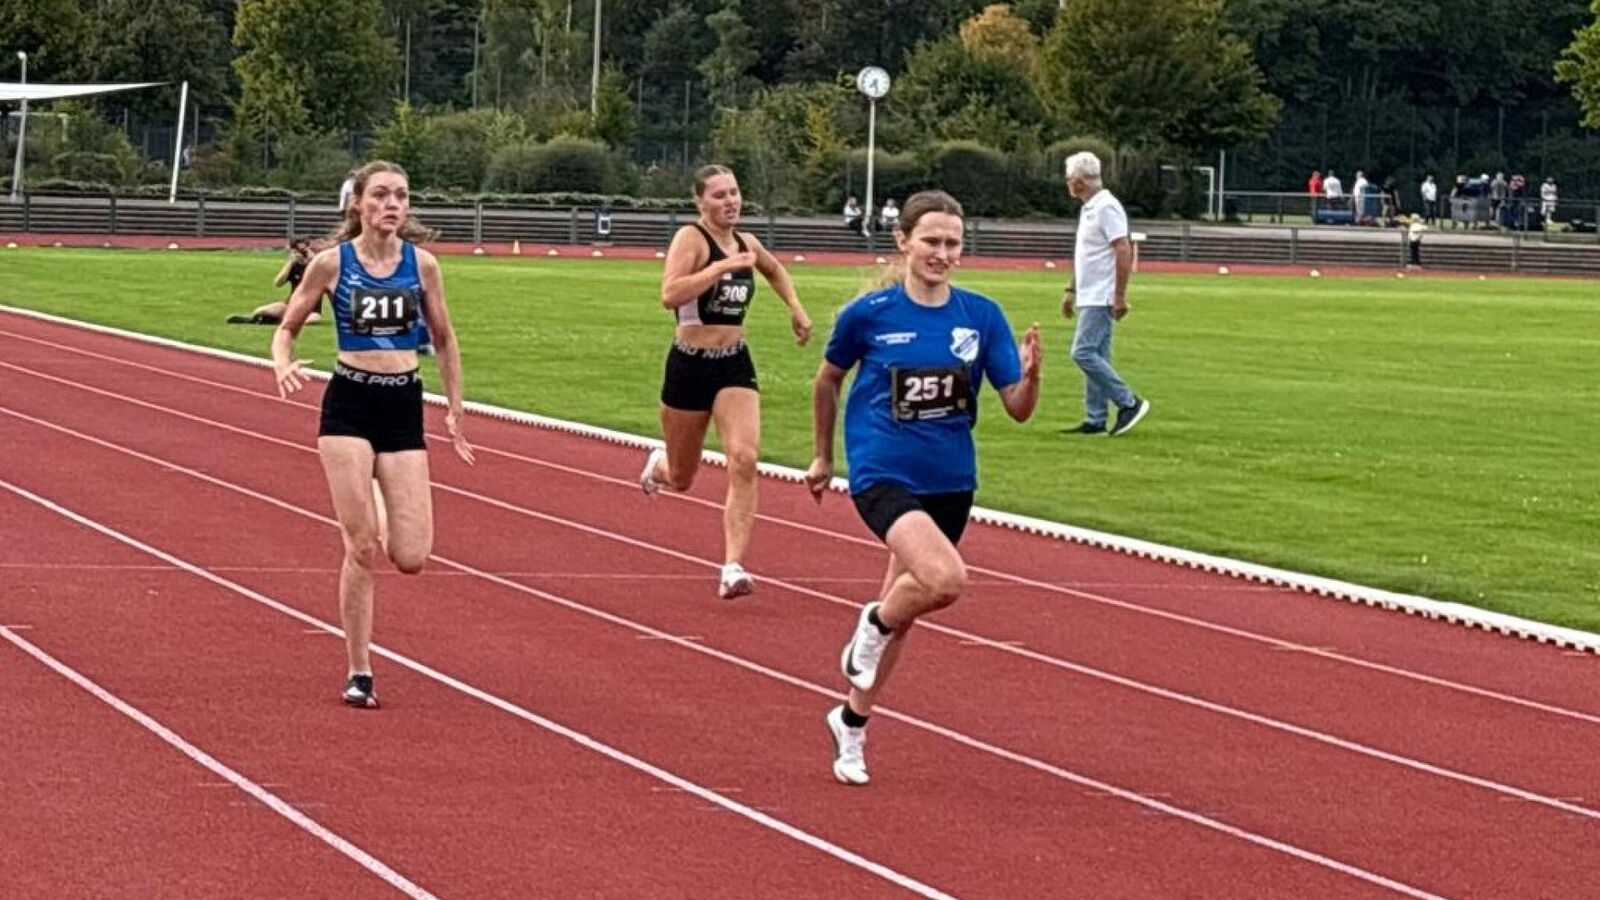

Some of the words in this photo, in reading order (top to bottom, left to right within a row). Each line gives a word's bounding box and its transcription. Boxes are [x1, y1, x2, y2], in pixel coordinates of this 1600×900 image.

[718, 285, 749, 303] 308
[361, 296, 404, 319] 211
[702, 345, 738, 359] NIKE
[367, 375, 409, 387] PRO
[904, 375, 954, 402] 251
